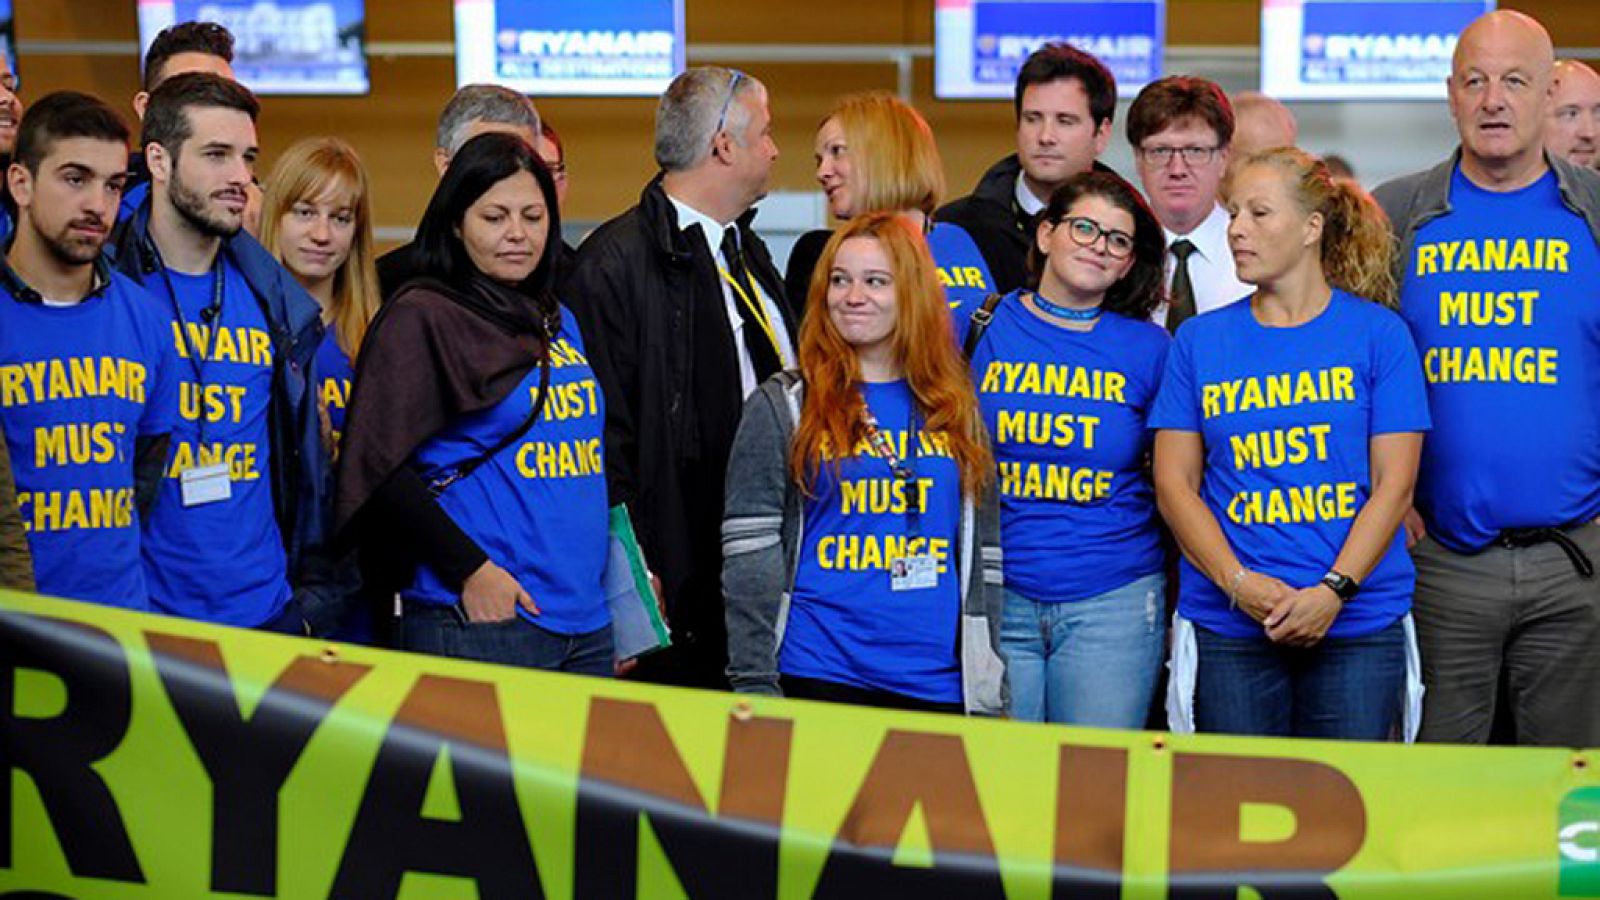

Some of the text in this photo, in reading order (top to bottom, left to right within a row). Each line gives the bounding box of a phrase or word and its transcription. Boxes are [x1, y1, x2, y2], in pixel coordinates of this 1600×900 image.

[519, 31, 674, 55] RYANAIR
[1417, 239, 1569, 275] RYANAIR
[1439, 291, 1540, 325] MUST
[980, 361, 1126, 404] RYANAIR
[1424, 347, 1558, 383] CHANGE
[1202, 366, 1355, 419] RYANAIR
[997, 410, 1100, 448] MUST
[1229, 424, 1331, 469] MUST
[1227, 482, 1356, 525] CHANGE
[0, 611, 1368, 900] RYANAIR
